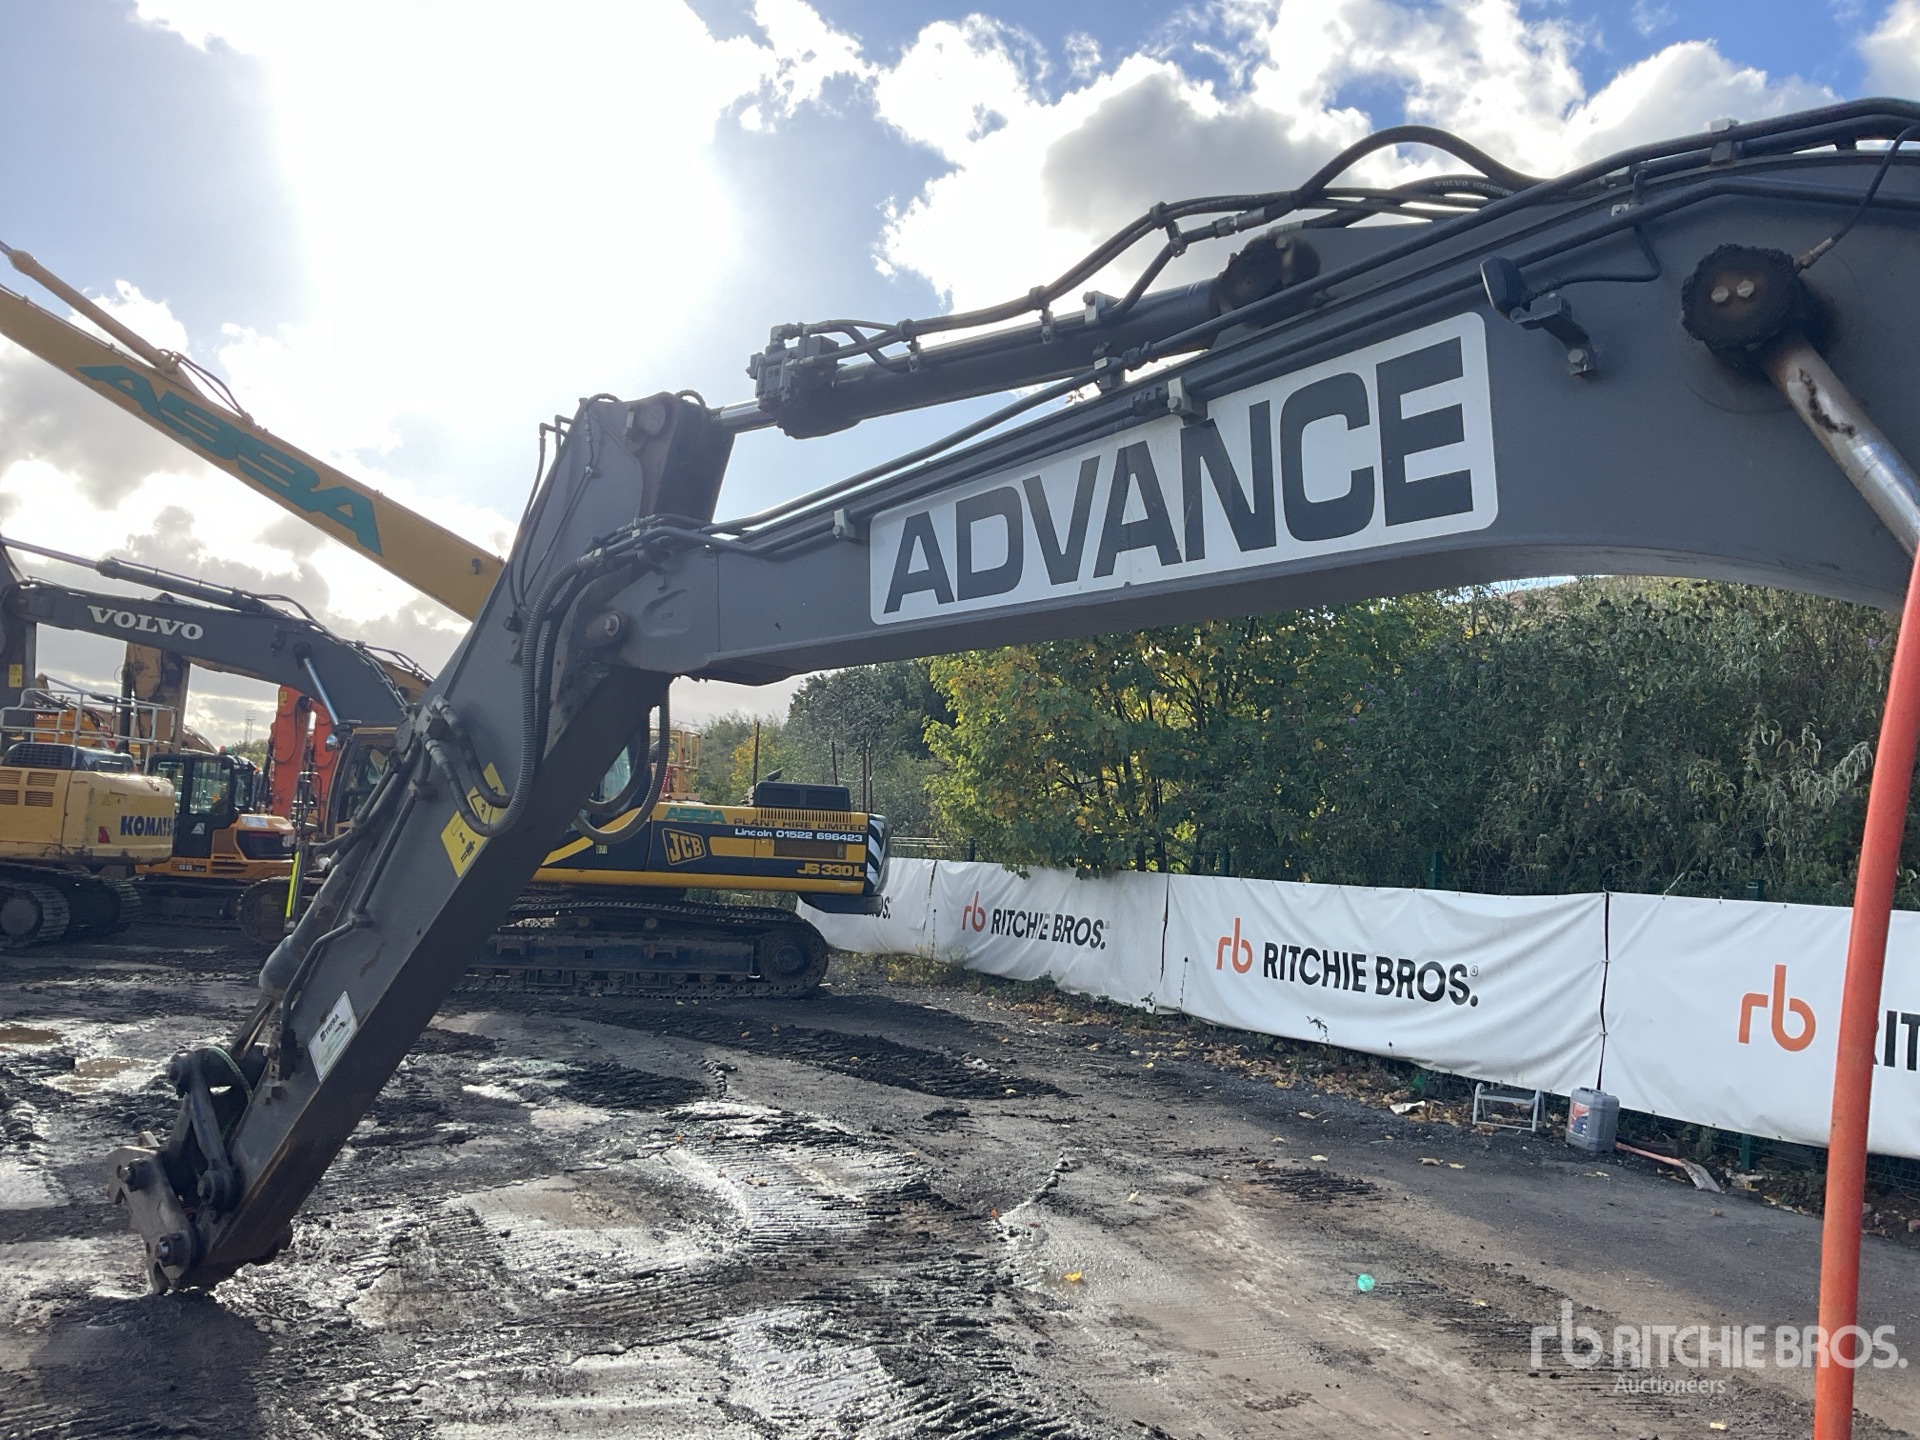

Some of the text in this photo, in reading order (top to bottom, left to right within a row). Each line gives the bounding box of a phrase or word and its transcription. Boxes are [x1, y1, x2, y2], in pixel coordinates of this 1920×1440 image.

[884, 336, 1474, 614] ADVANCE
[87, 605, 204, 640] VOLVO
[669, 832, 702, 861] JCB
[733, 818, 868, 832] PLANT HIRE LIMITED
[735, 828, 863, 842] Lincoln 01522 696423
[961, 891, 1106, 950] rb RITCHIE BROS.
[1216, 917, 1479, 1007] rb RITCHIE BROS.
[1738, 964, 1816, 1052] rb
